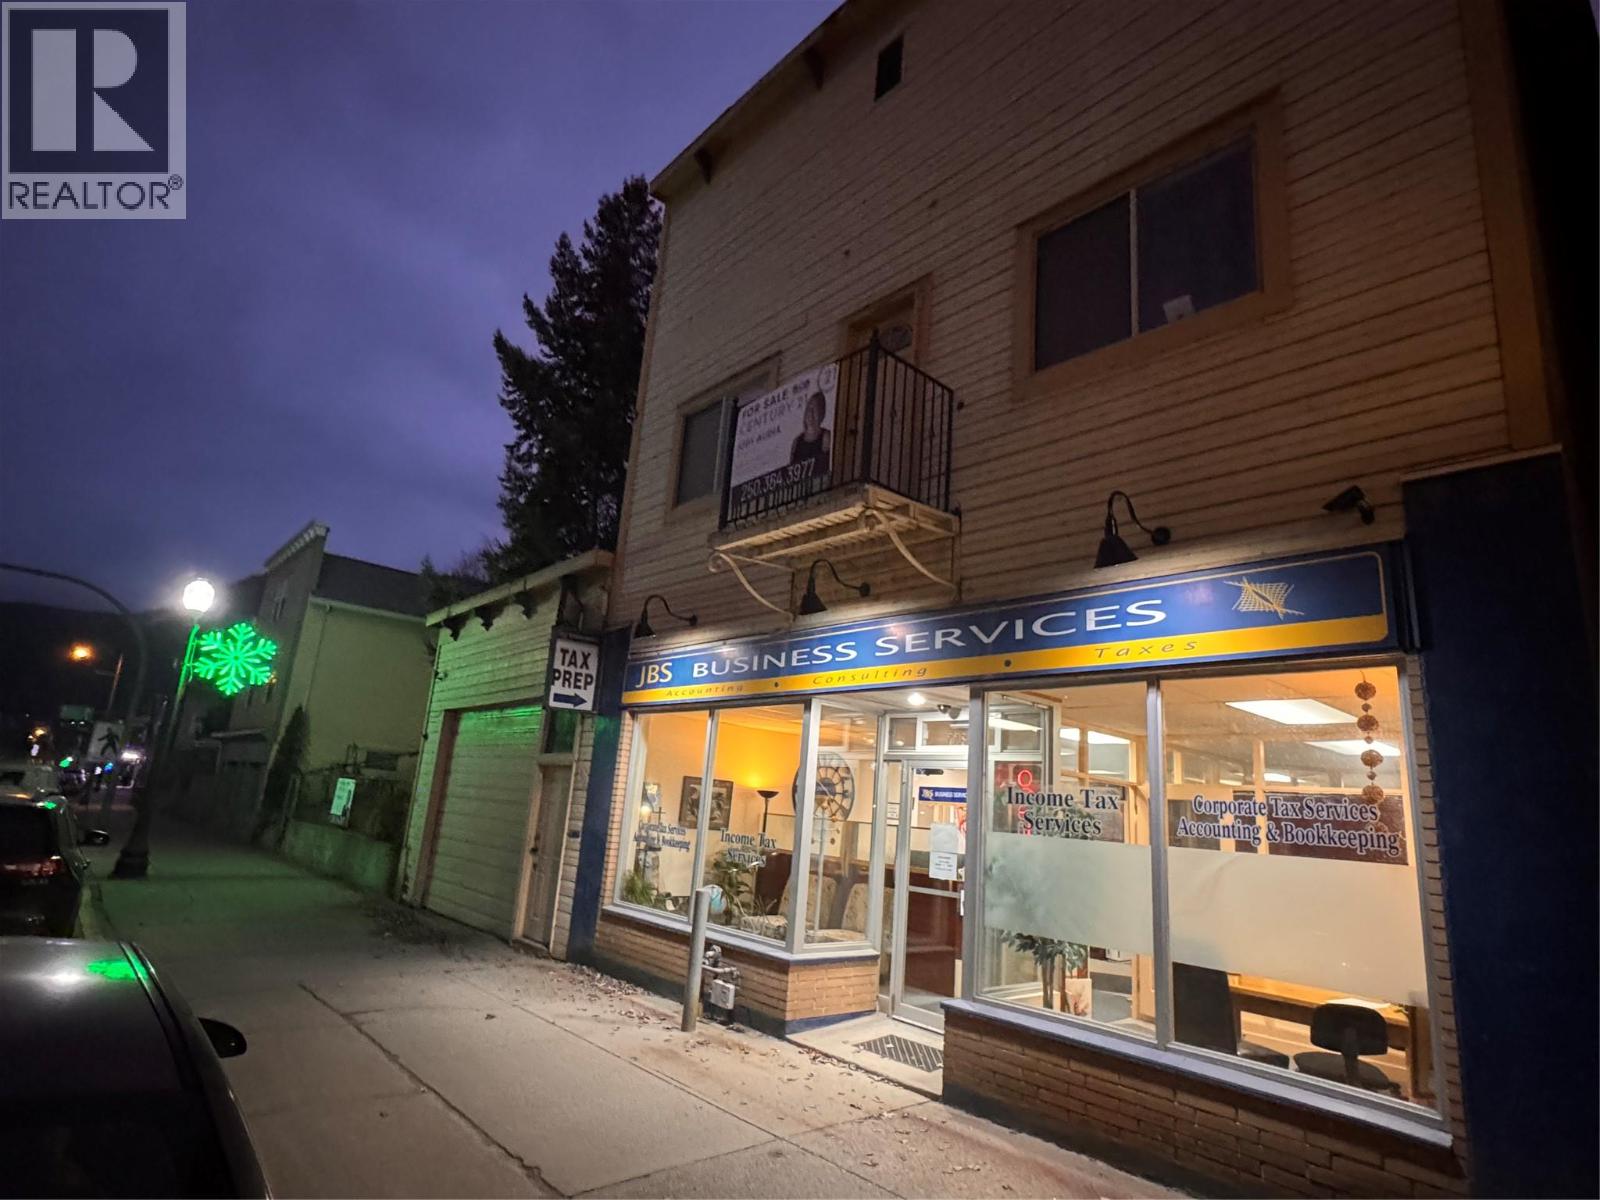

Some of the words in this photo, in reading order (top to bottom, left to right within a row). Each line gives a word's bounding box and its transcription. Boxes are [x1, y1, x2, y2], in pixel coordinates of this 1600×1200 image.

[741, 401, 760, 418] FOR
[763, 389, 788, 412] SALE
[635, 661, 674, 688] JBS
[692, 640, 858, 679] BUSINESS
[874, 598, 1168, 658] SERVICES
[559, 647, 591, 670] TAX
[665, 684, 745, 698] Accounting
[812, 664, 929, 686] Consulting
[1094, 638, 1199, 659] Taxes
[551, 668, 594, 691] PREP
[1007, 786, 1074, 809] Income
[1080, 788, 1122, 811] Tax
[1192, 794, 1267, 819] Corporate
[1269, 797, 1301, 820] Tax
[1302, 797, 1379, 822] Services
[1023, 811, 1102, 837] Services
[1176, 816, 1262, 846] Accounting
[1265, 822, 1279, 842] &
[1282, 822, 1400, 857] Bookkeeping
[719, 828, 755, 846] Income
[757, 831, 778, 850] Tax
[726, 848, 767, 867] Services
